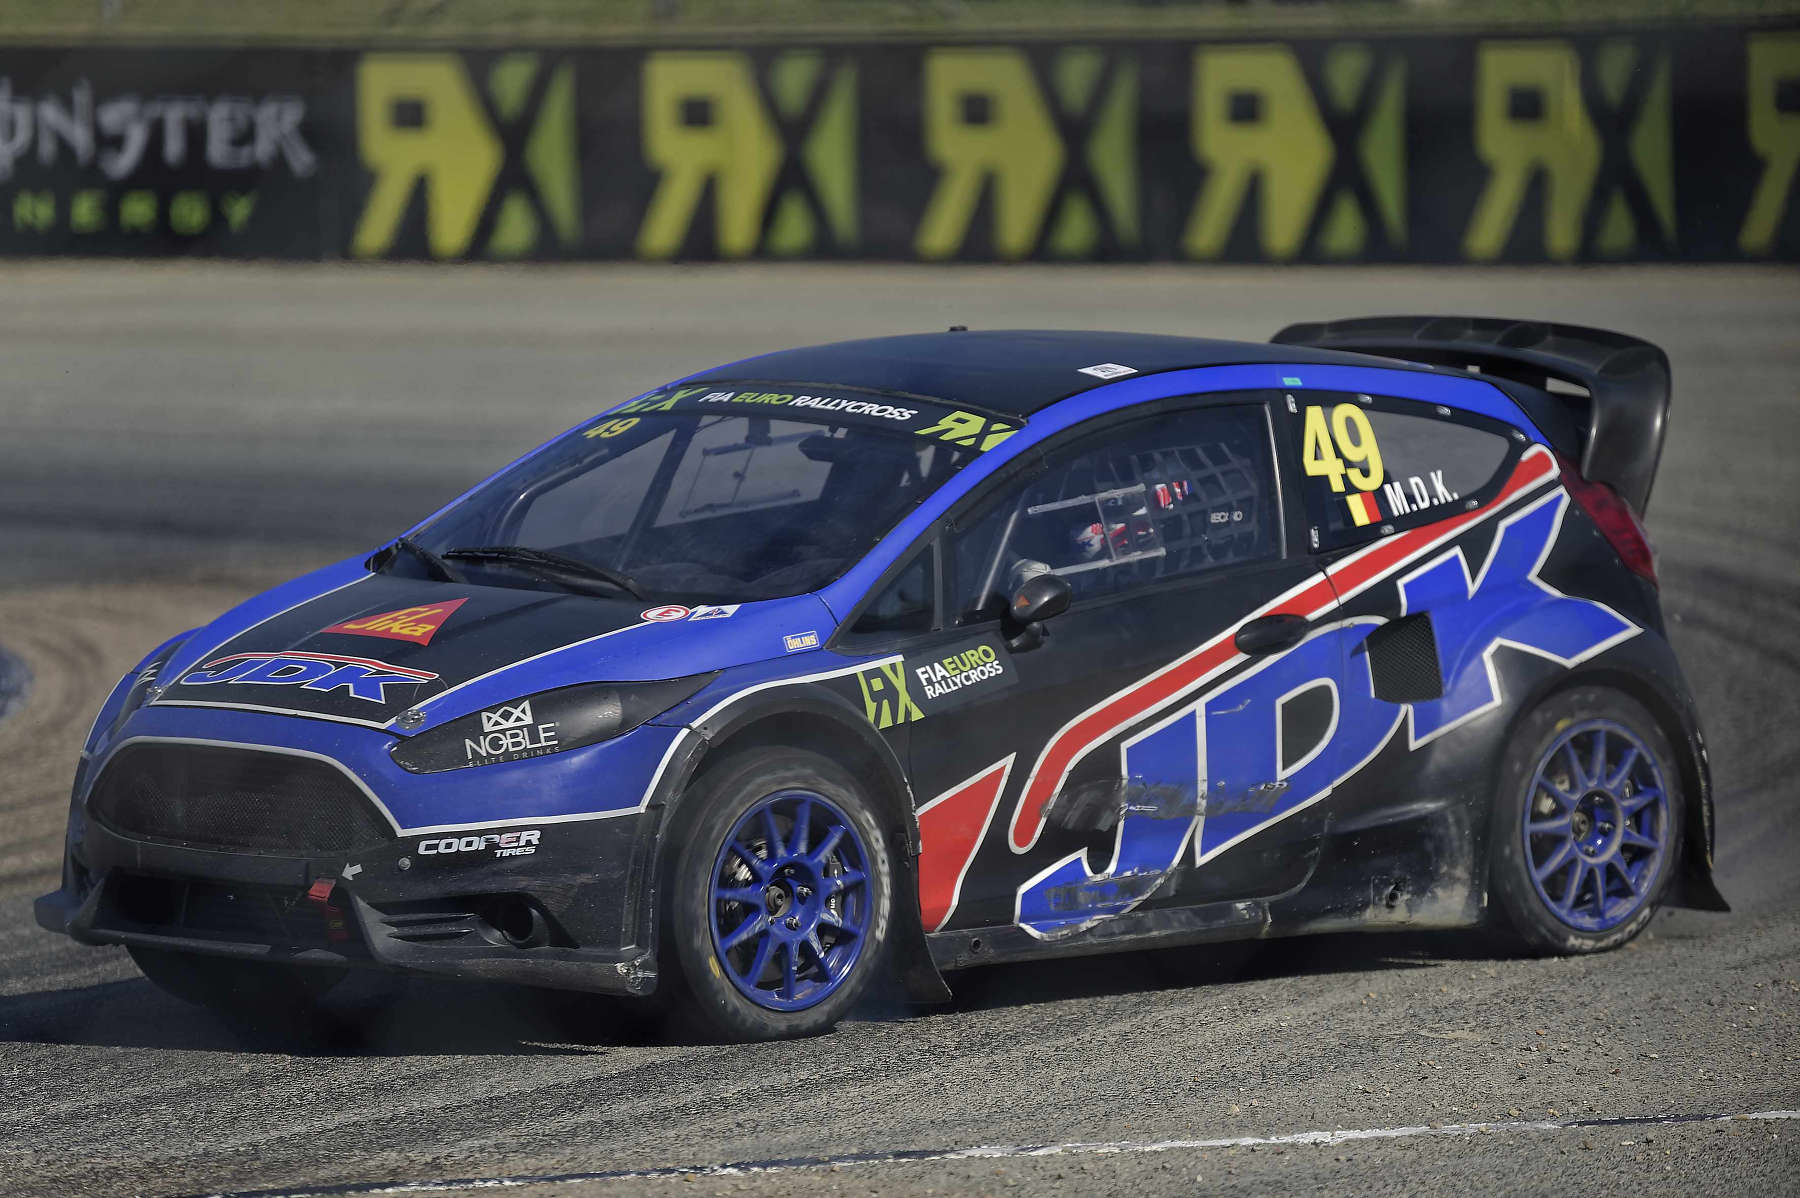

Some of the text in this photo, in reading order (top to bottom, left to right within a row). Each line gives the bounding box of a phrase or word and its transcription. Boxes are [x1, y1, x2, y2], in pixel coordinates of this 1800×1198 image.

[699, 392, 919, 421] FIA EURO RALLYCROSS
[582, 417, 641, 439] 49
[1303, 403, 1384, 493] 49
[1383, 469, 1459, 518] M.D.K.
[343, 607, 444, 636] Sika
[180, 656, 430, 705] JDK
[924, 660, 1003, 699] RALLYCROSS
[1015, 486, 1645, 941] JDK
[464, 722, 558, 760] NOBLE
[468, 747, 560, 768] ELITE DRINKS
[417, 829, 541, 855] COOPER
[494, 845, 536, 858] TIRES
